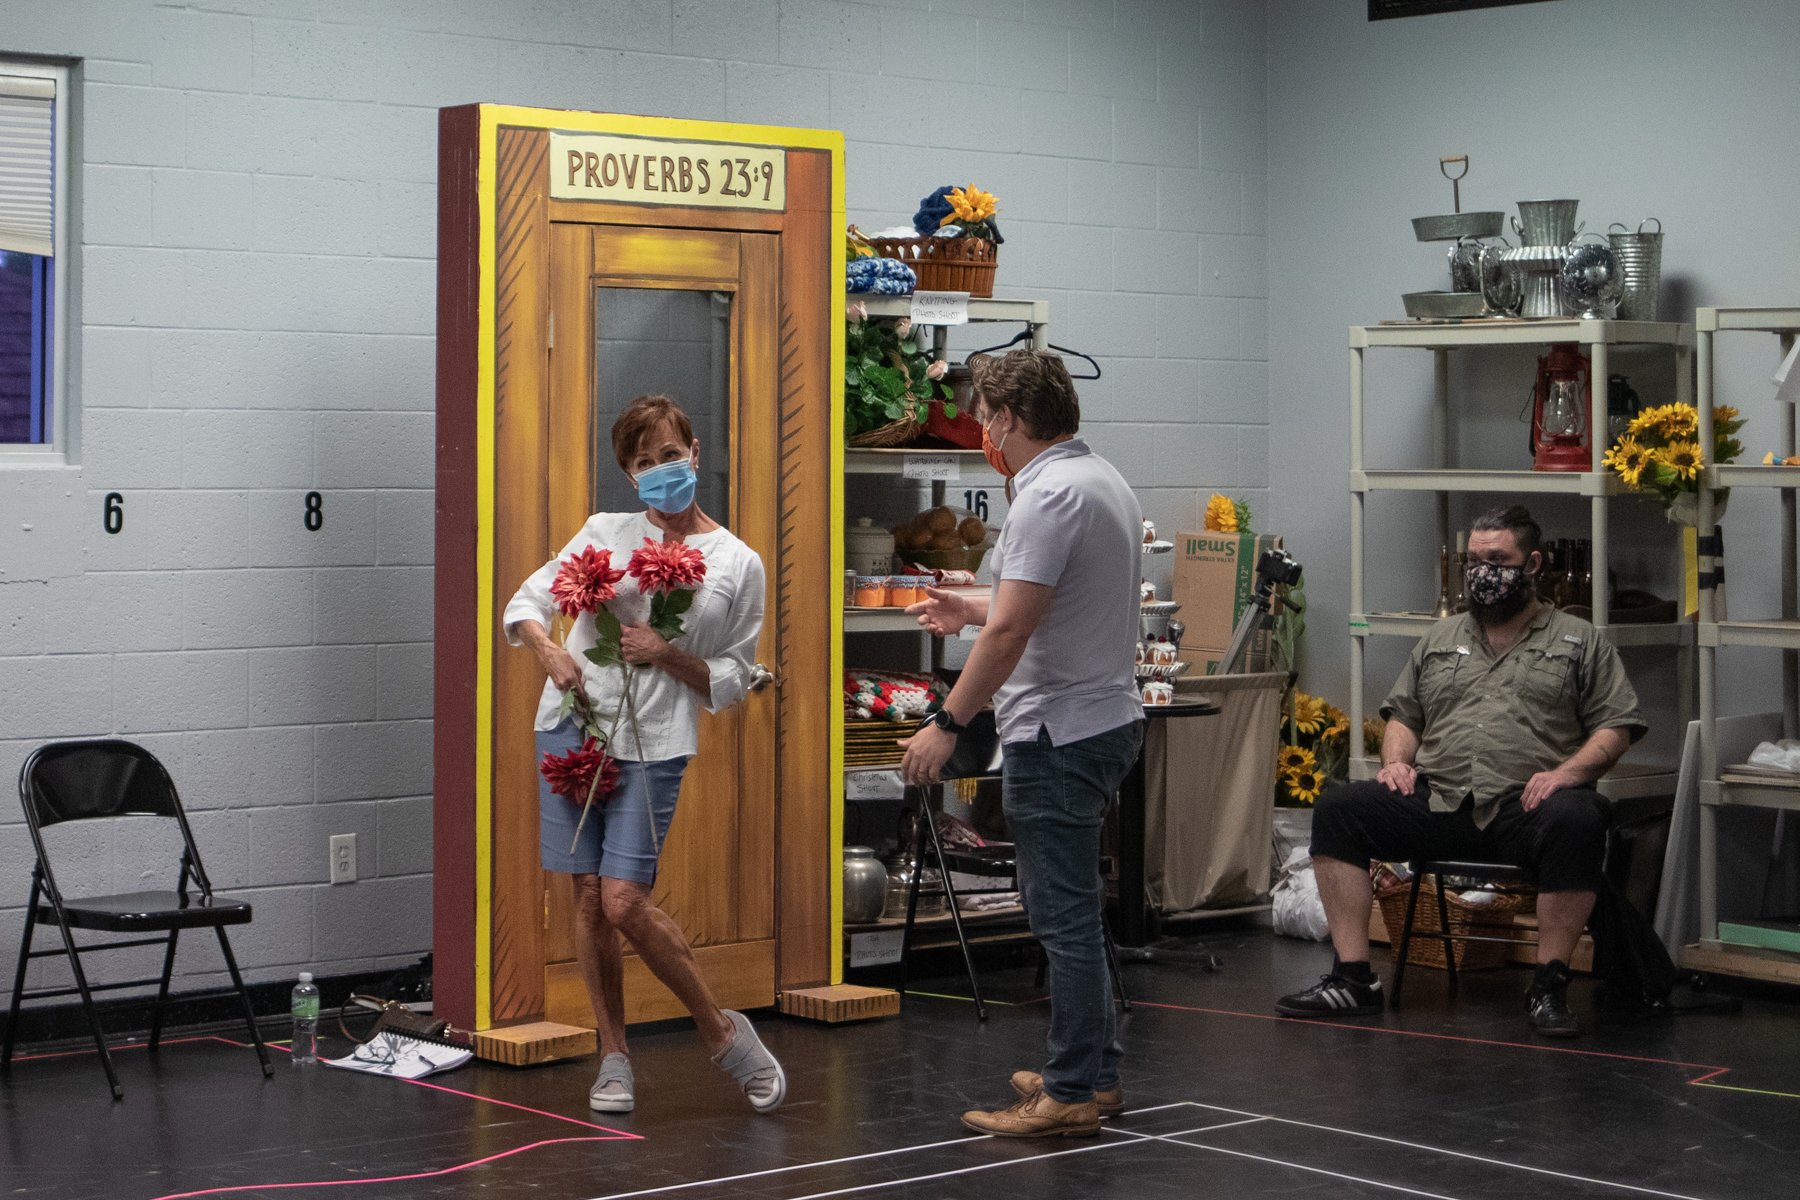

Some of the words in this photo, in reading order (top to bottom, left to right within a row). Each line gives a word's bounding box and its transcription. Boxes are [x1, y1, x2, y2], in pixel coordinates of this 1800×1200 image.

[567, 149, 711, 195] PROVERBS
[719, 157, 774, 202] 23:9
[919, 295, 958, 306] KNITTING
[103, 491, 124, 535] 6
[303, 491, 323, 532] 8
[963, 489, 989, 523] 16
[1186, 538, 1236, 556] Small
